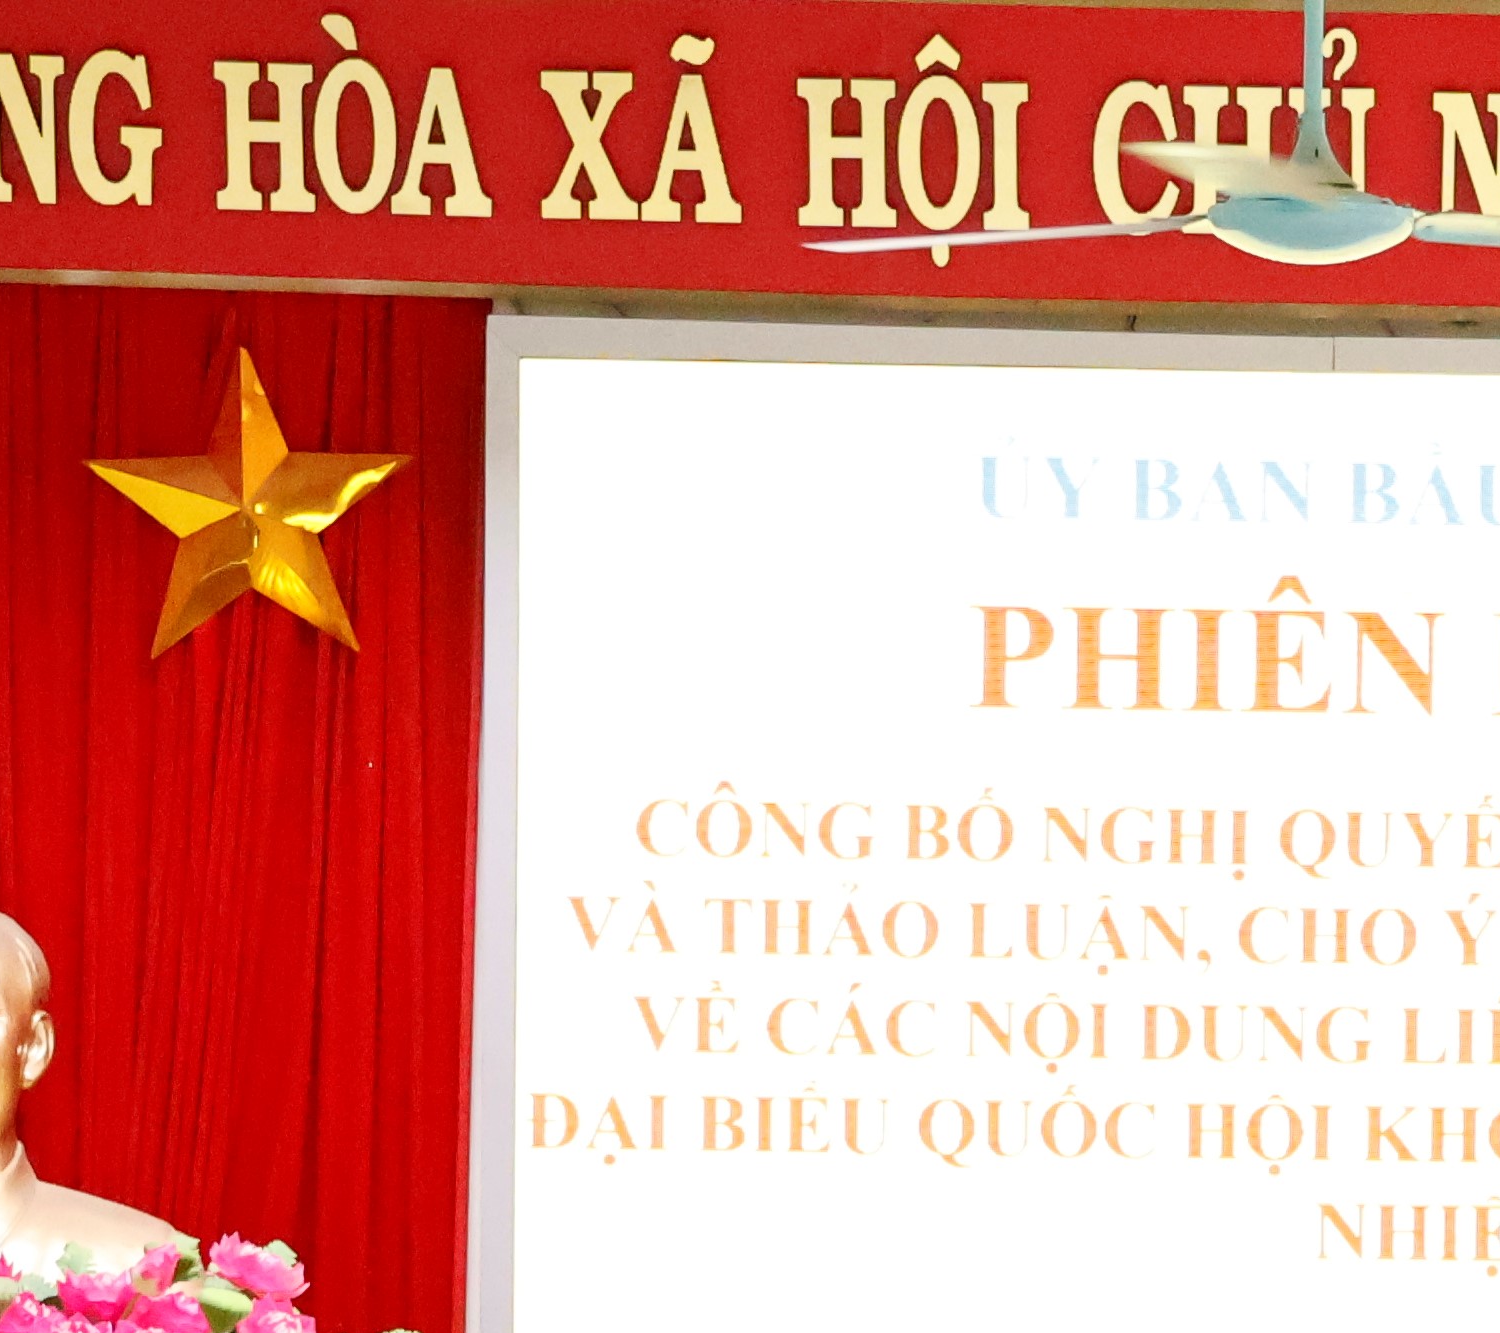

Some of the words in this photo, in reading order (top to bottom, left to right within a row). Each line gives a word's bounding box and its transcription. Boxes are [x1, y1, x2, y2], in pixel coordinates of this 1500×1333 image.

[213, 14, 493, 217] HÒA
[539, 34, 743, 225] XÃ
[796, 34, 1032, 268] HỘI
[1133, 458, 1312, 523] BAN
[971, 574, 1445, 717] PHIÊN
[635, 779, 874, 861] CÔNG
[906, 786, 1015, 863] BỐ
[1043, 806, 1249, 879] NGHỊ
[567, 879, 677, 955] VÀ
[703, 883, 940, 960] THẢO
[968, 894, 1213, 977] LUẬN,
[1237, 906, 1418, 967] CHO
[1444, 892, 1497, 967] Ý
[634, 979, 740, 1055] VỀ
[765, 981, 936, 1059] CÁC
[964, 992, 1109, 1076] NỘI
[1141, 1003, 1372, 1065] DUNG
[530, 1092, 668, 1168] ĐẠI
[701, 1085, 889, 1156] BIỂU
[918, 1083, 1157, 1169] QUỐC
[1186, 1093, 1333, 1178] HỘI
